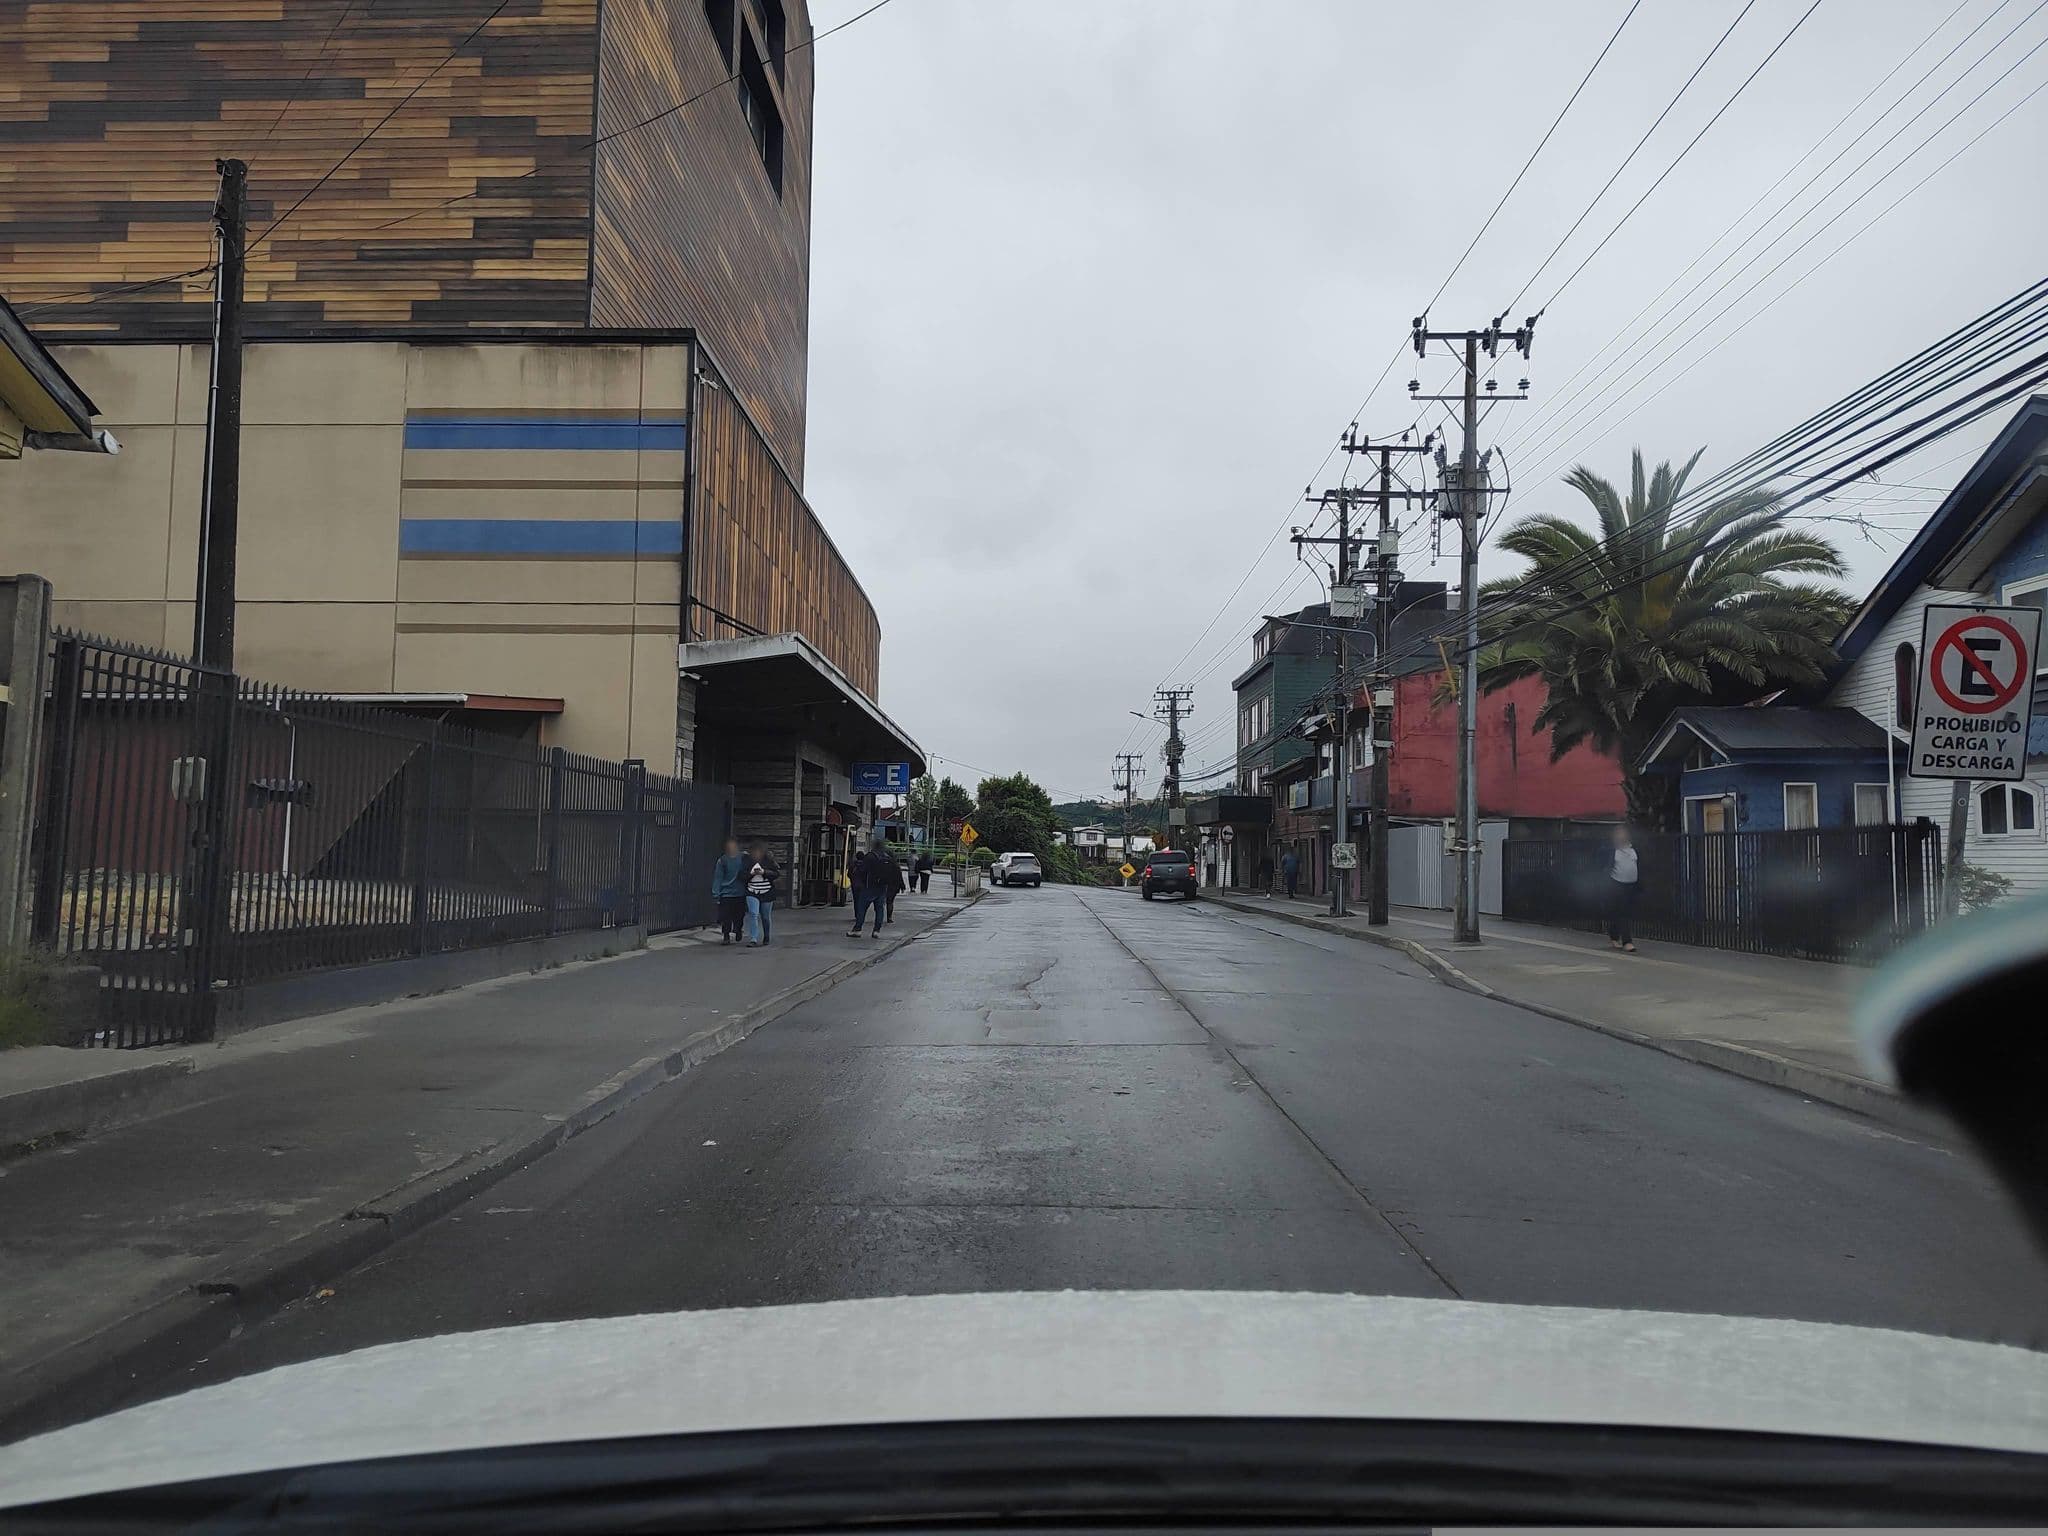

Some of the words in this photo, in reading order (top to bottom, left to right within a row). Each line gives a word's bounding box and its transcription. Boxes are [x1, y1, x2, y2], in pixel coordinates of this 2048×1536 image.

[1960, 638, 2001, 696] E
[1924, 717, 2021, 733] PROHIBIDO
[1931, 736, 1989, 751] CARGA
[1997, 739, 2007, 752] Y
[1922, 754, 2015, 770] DESCARGA
[887, 765, 900, 785] E
